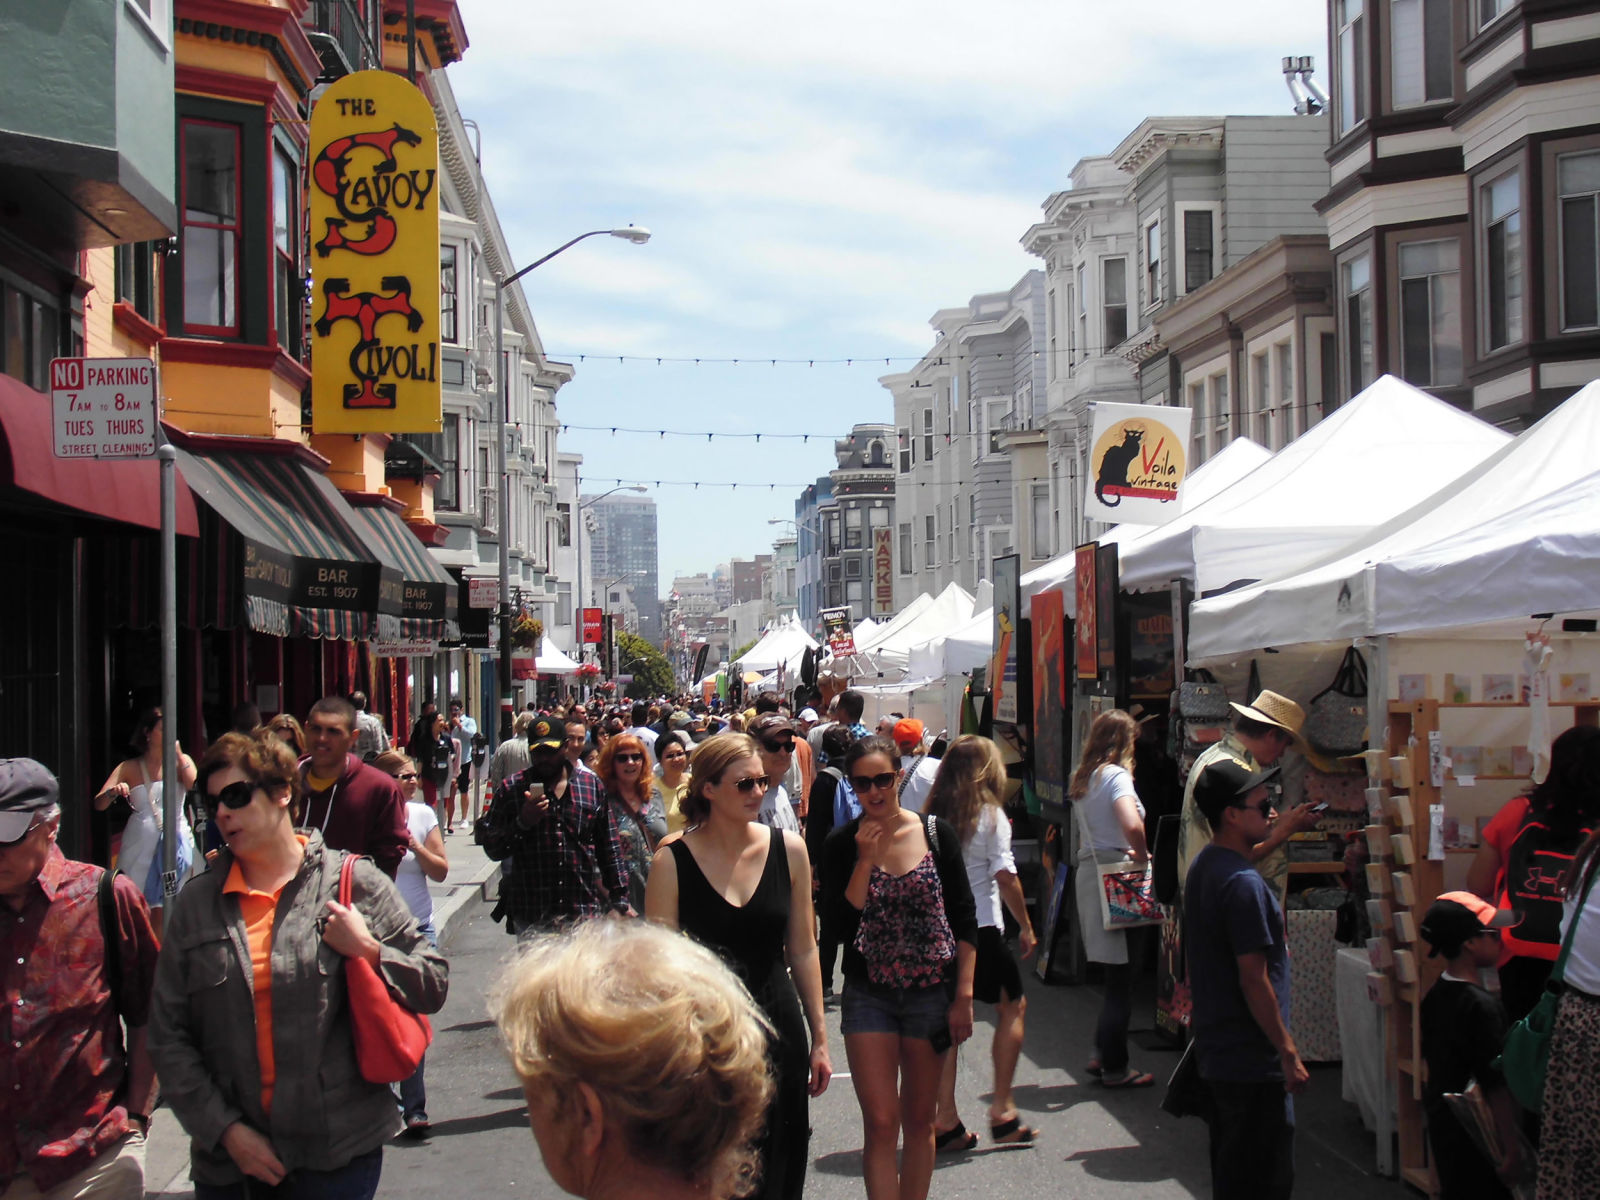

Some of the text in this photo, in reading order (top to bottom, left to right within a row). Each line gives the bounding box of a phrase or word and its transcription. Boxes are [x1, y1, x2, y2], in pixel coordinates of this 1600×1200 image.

[336, 98, 376, 116] THE
[313, 122, 436, 258] SAVOY
[314, 276, 437, 409] TIVOLI
[54, 362, 149, 387] NO PARKING
[67, 393, 92, 412] 7AM
[114, 393, 141, 412] 8AM
[64, 419, 145, 436] TUES THURS
[62, 442, 148, 455] STREET CLEANING
[1142, 436, 1176, 476] Voila
[1130, 474, 1178, 492] vintage
[318, 567, 348, 583] BAR
[876, 529, 892, 612] MARKET
[308, 586, 359, 599] EST. 1907
[405, 587, 428, 600] BAR
[415, 601, 433, 611] 1907
